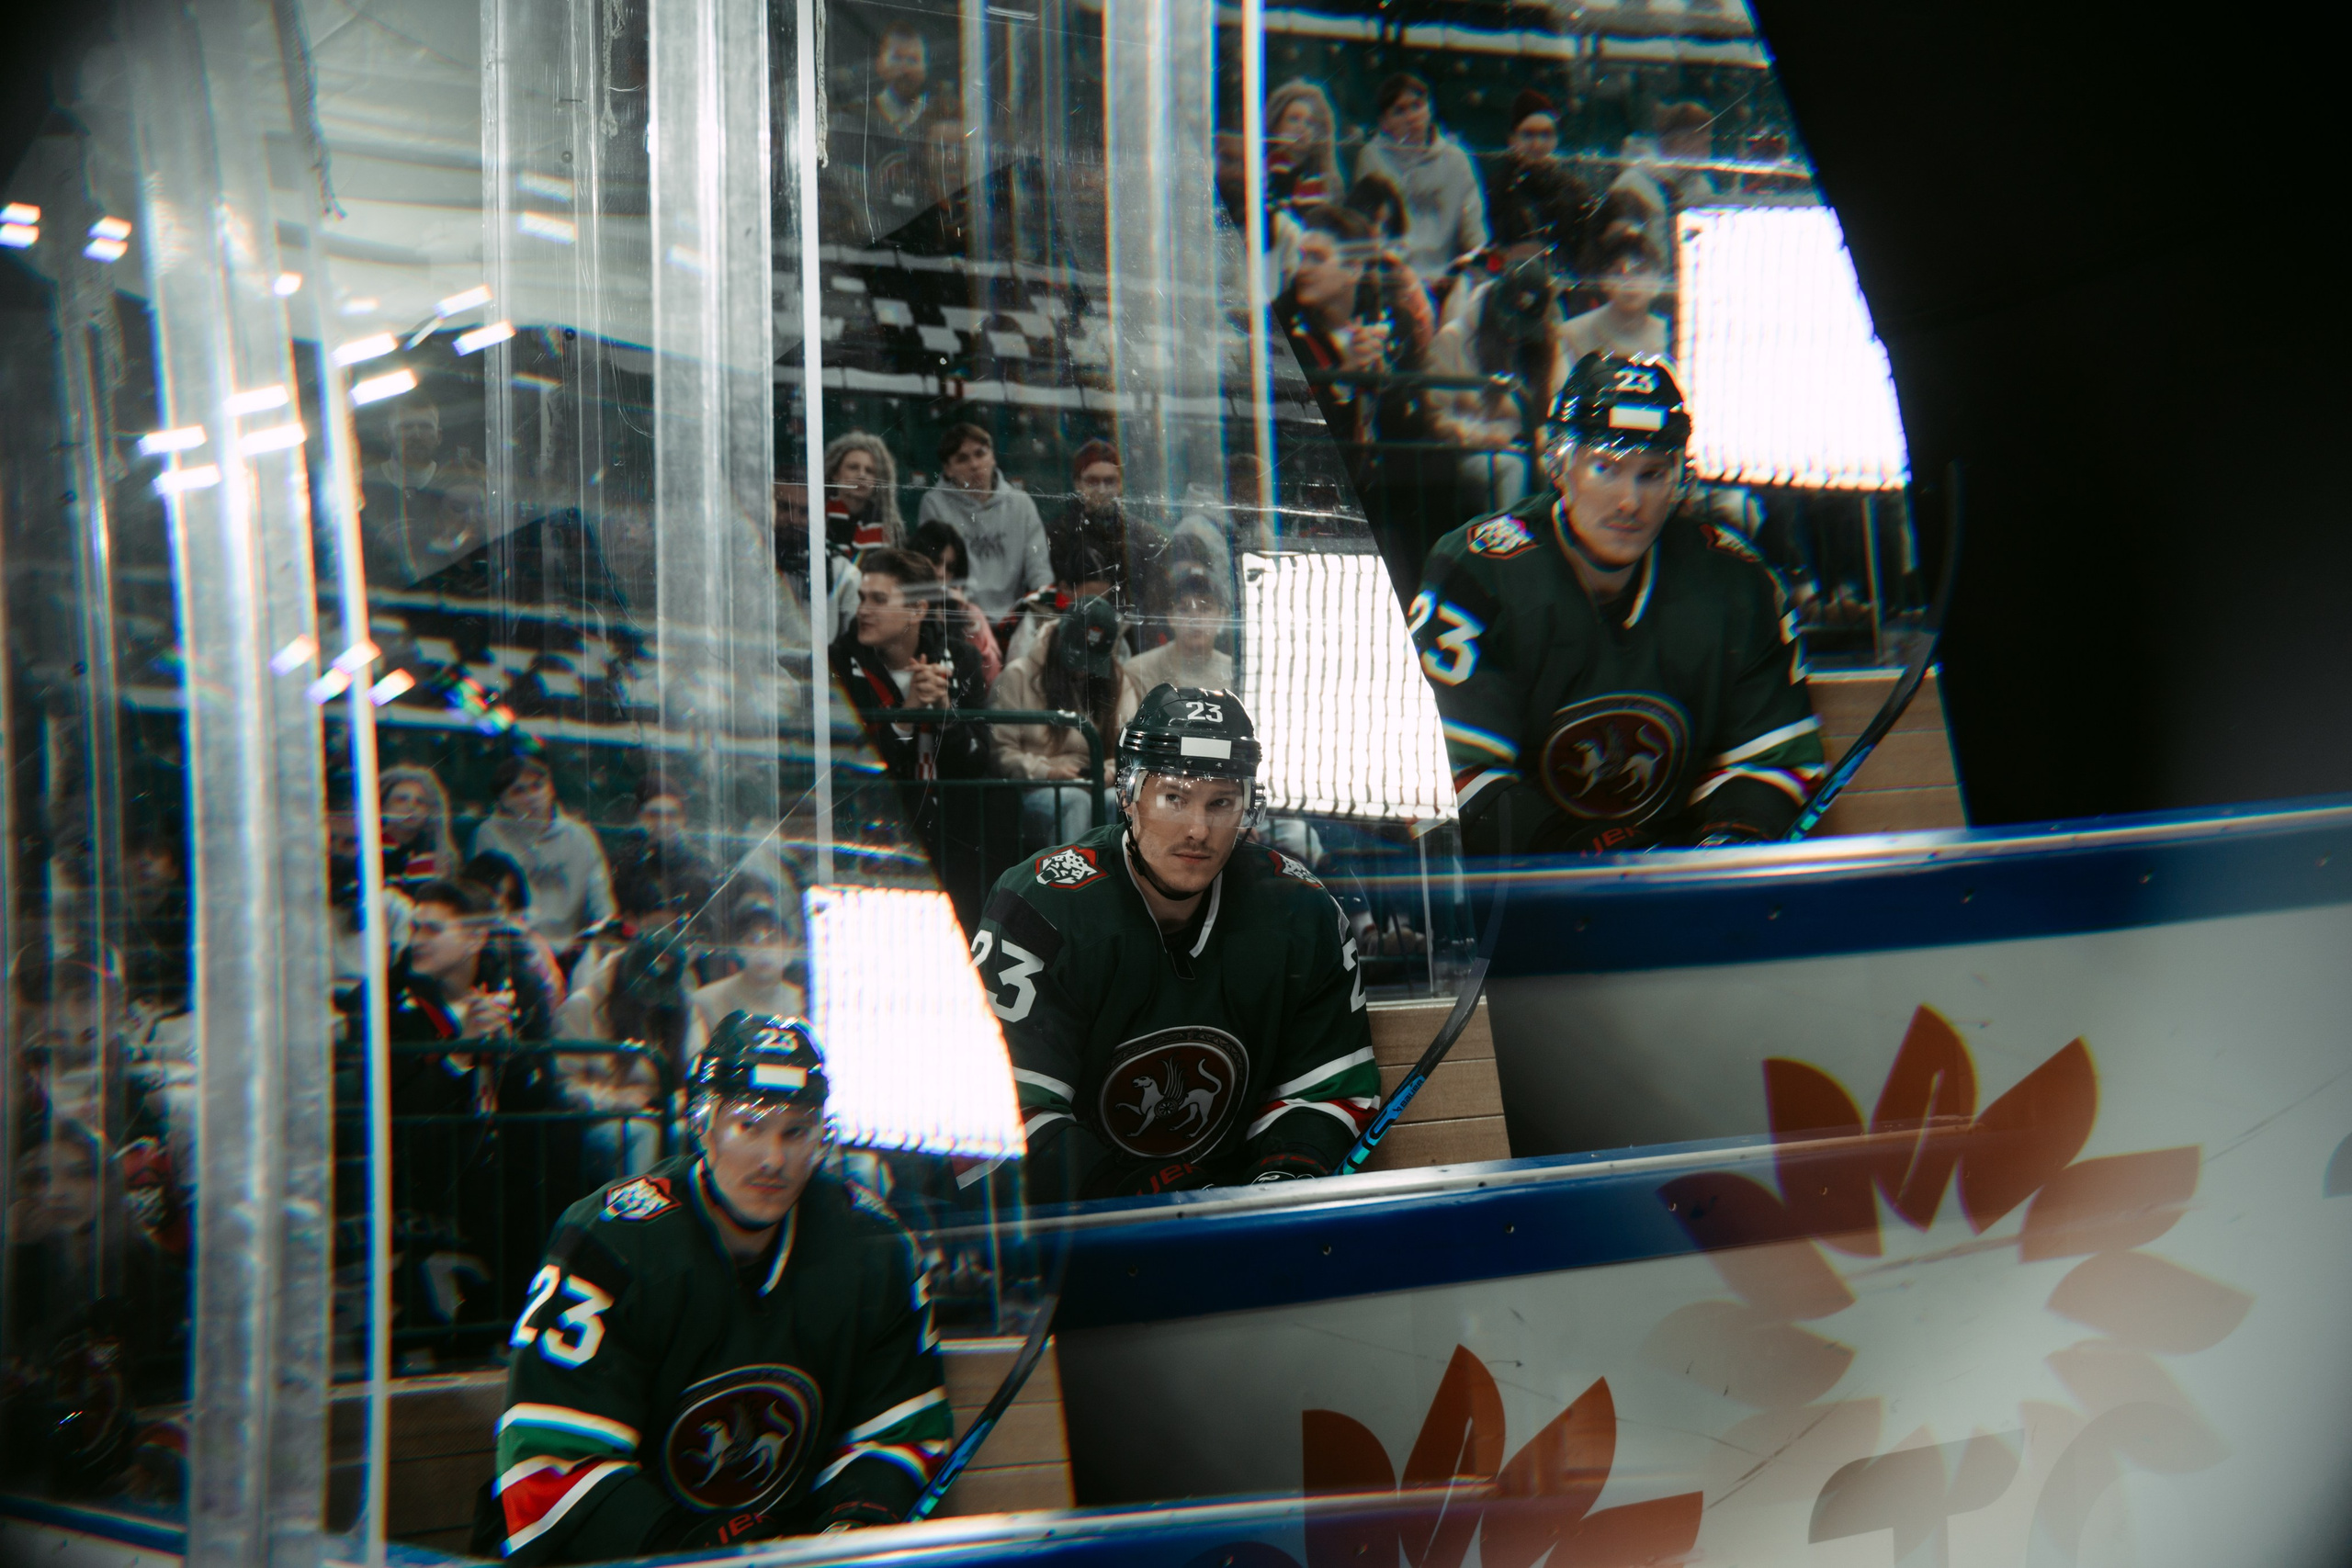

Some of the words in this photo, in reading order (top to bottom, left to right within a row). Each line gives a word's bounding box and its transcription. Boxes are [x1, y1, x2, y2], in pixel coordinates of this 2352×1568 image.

[1613, 367, 1658, 394] 23
[1186, 702, 1223, 723] 23
[752, 1027, 798, 1055] 23
[510, 1264, 614, 1369] 23
